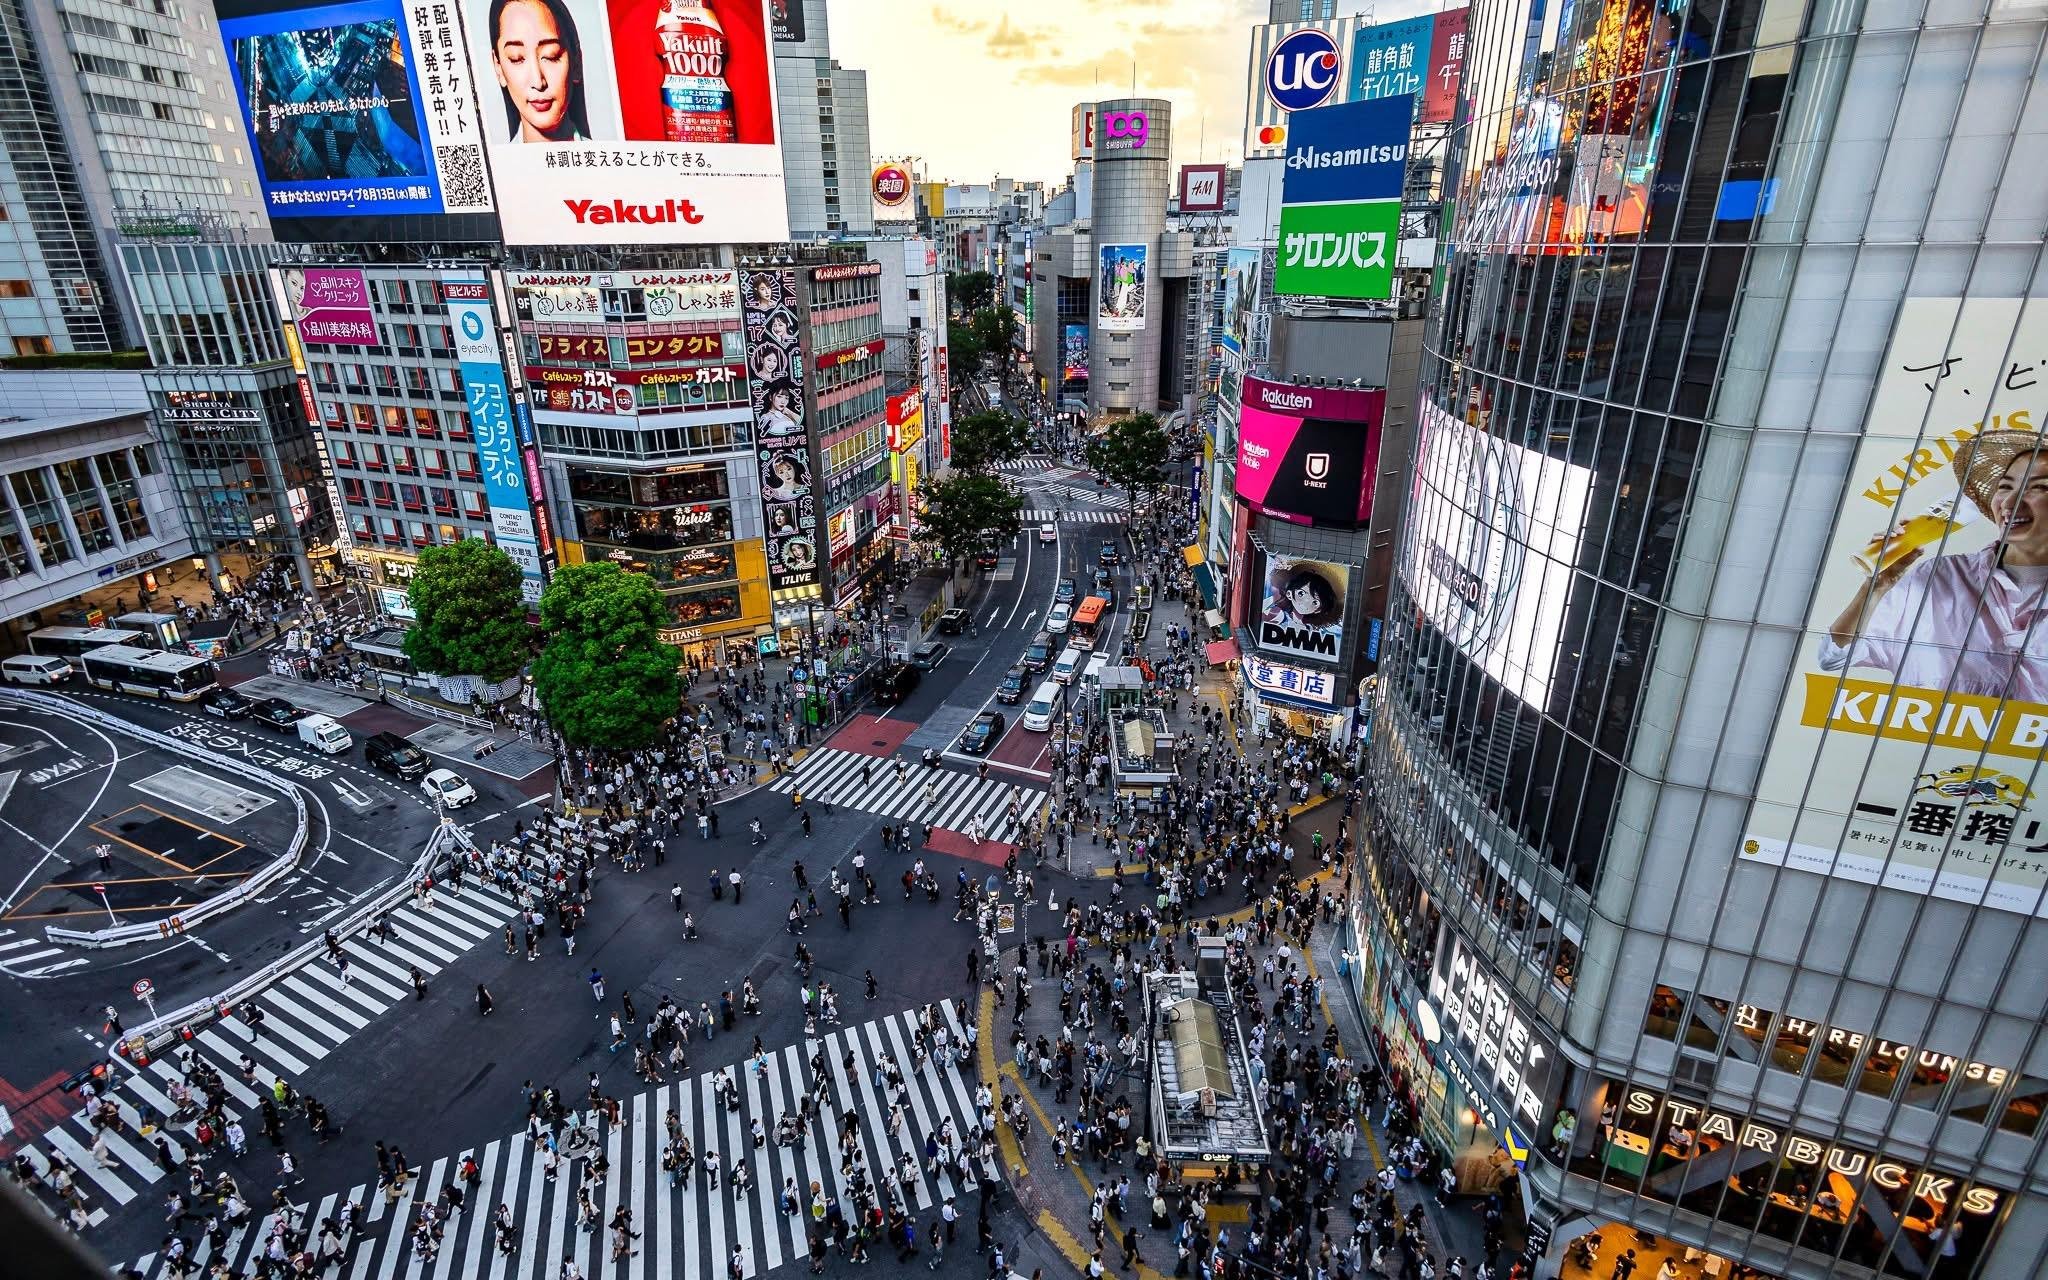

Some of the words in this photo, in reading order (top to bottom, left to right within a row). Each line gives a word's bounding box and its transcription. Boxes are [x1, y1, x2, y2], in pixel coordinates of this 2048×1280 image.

[659, 32, 724, 55] Yakult
[432, 4, 467, 134] 配信チケット
[662, 52, 723, 76] 1000
[1368, 42, 1415, 74] 龍角散
[415, 6, 450, 136] 好評発売中!!
[1360, 71, 1419, 101] ダイレクト
[1103, 111, 1149, 150] 109
[1105, 140, 1133, 150] SHIBUYA
[545, 150, 713, 170] 体調は変えることができる。
[1287, 144, 1406, 170] Hisamitsu
[563, 199, 704, 225] Yakult
[1285, 232, 1386, 269] サロンパス
[320, 276, 361, 289] 品川スキン
[518, 274, 592, 286] しゃぶしゃぶバイキング
[632, 272, 733, 286] しゃぶしゃぶバイキング
[323, 290, 360, 303] クリニック
[448, 284, 484, 299] 当ビル5F
[677, 289, 736, 312] しゃぶ葉
[517, 297, 532, 310] 9F
[555, 294, 599, 313] しゃぶ葉
[311, 321, 373, 339] 品川美容外科
[461, 342, 495, 357] eyecity
[539, 337, 608, 355] プライス
[628, 335, 720, 357] コンタクト
[584, 369, 617, 387] ガスト
[696, 366, 738, 384] ガスト
[532, 388, 549, 400] 7F
[570, 389, 611, 411] ガスト
[1262, 387, 1313, 409] Rakuten
[163, 409, 213, 418] MARK
[220, 409, 260, 418] CITY
[468, 382, 503, 487] アイシティ
[488, 383, 520, 488] コンタクトの
[1243, 440, 1269, 458] Rakuten
[1241, 453, 1260, 470] Mobile
[1303, 479, 1328, 489] U-NEXT
[499, 512, 522, 521] CONTACT
[498, 525, 530, 535] SPECIALISTS
[873, 521, 890, 543] LUSH
[781, 573, 812, 585] 17LIVE
[1262, 622, 1336, 657] DMM
[1830, 686, 2005, 743] KIRIN
[1848, 829, 2048, 877] 暑中お見舞い申し上げます。
[1778, 1016, 1863, 1048] HARE
[1877, 1039, 2010, 1086] LOUNGE
[1443, 1050, 1497, 1129] TSUTAYA
[1626, 1091, 1999, 1215] STARBUCKS
